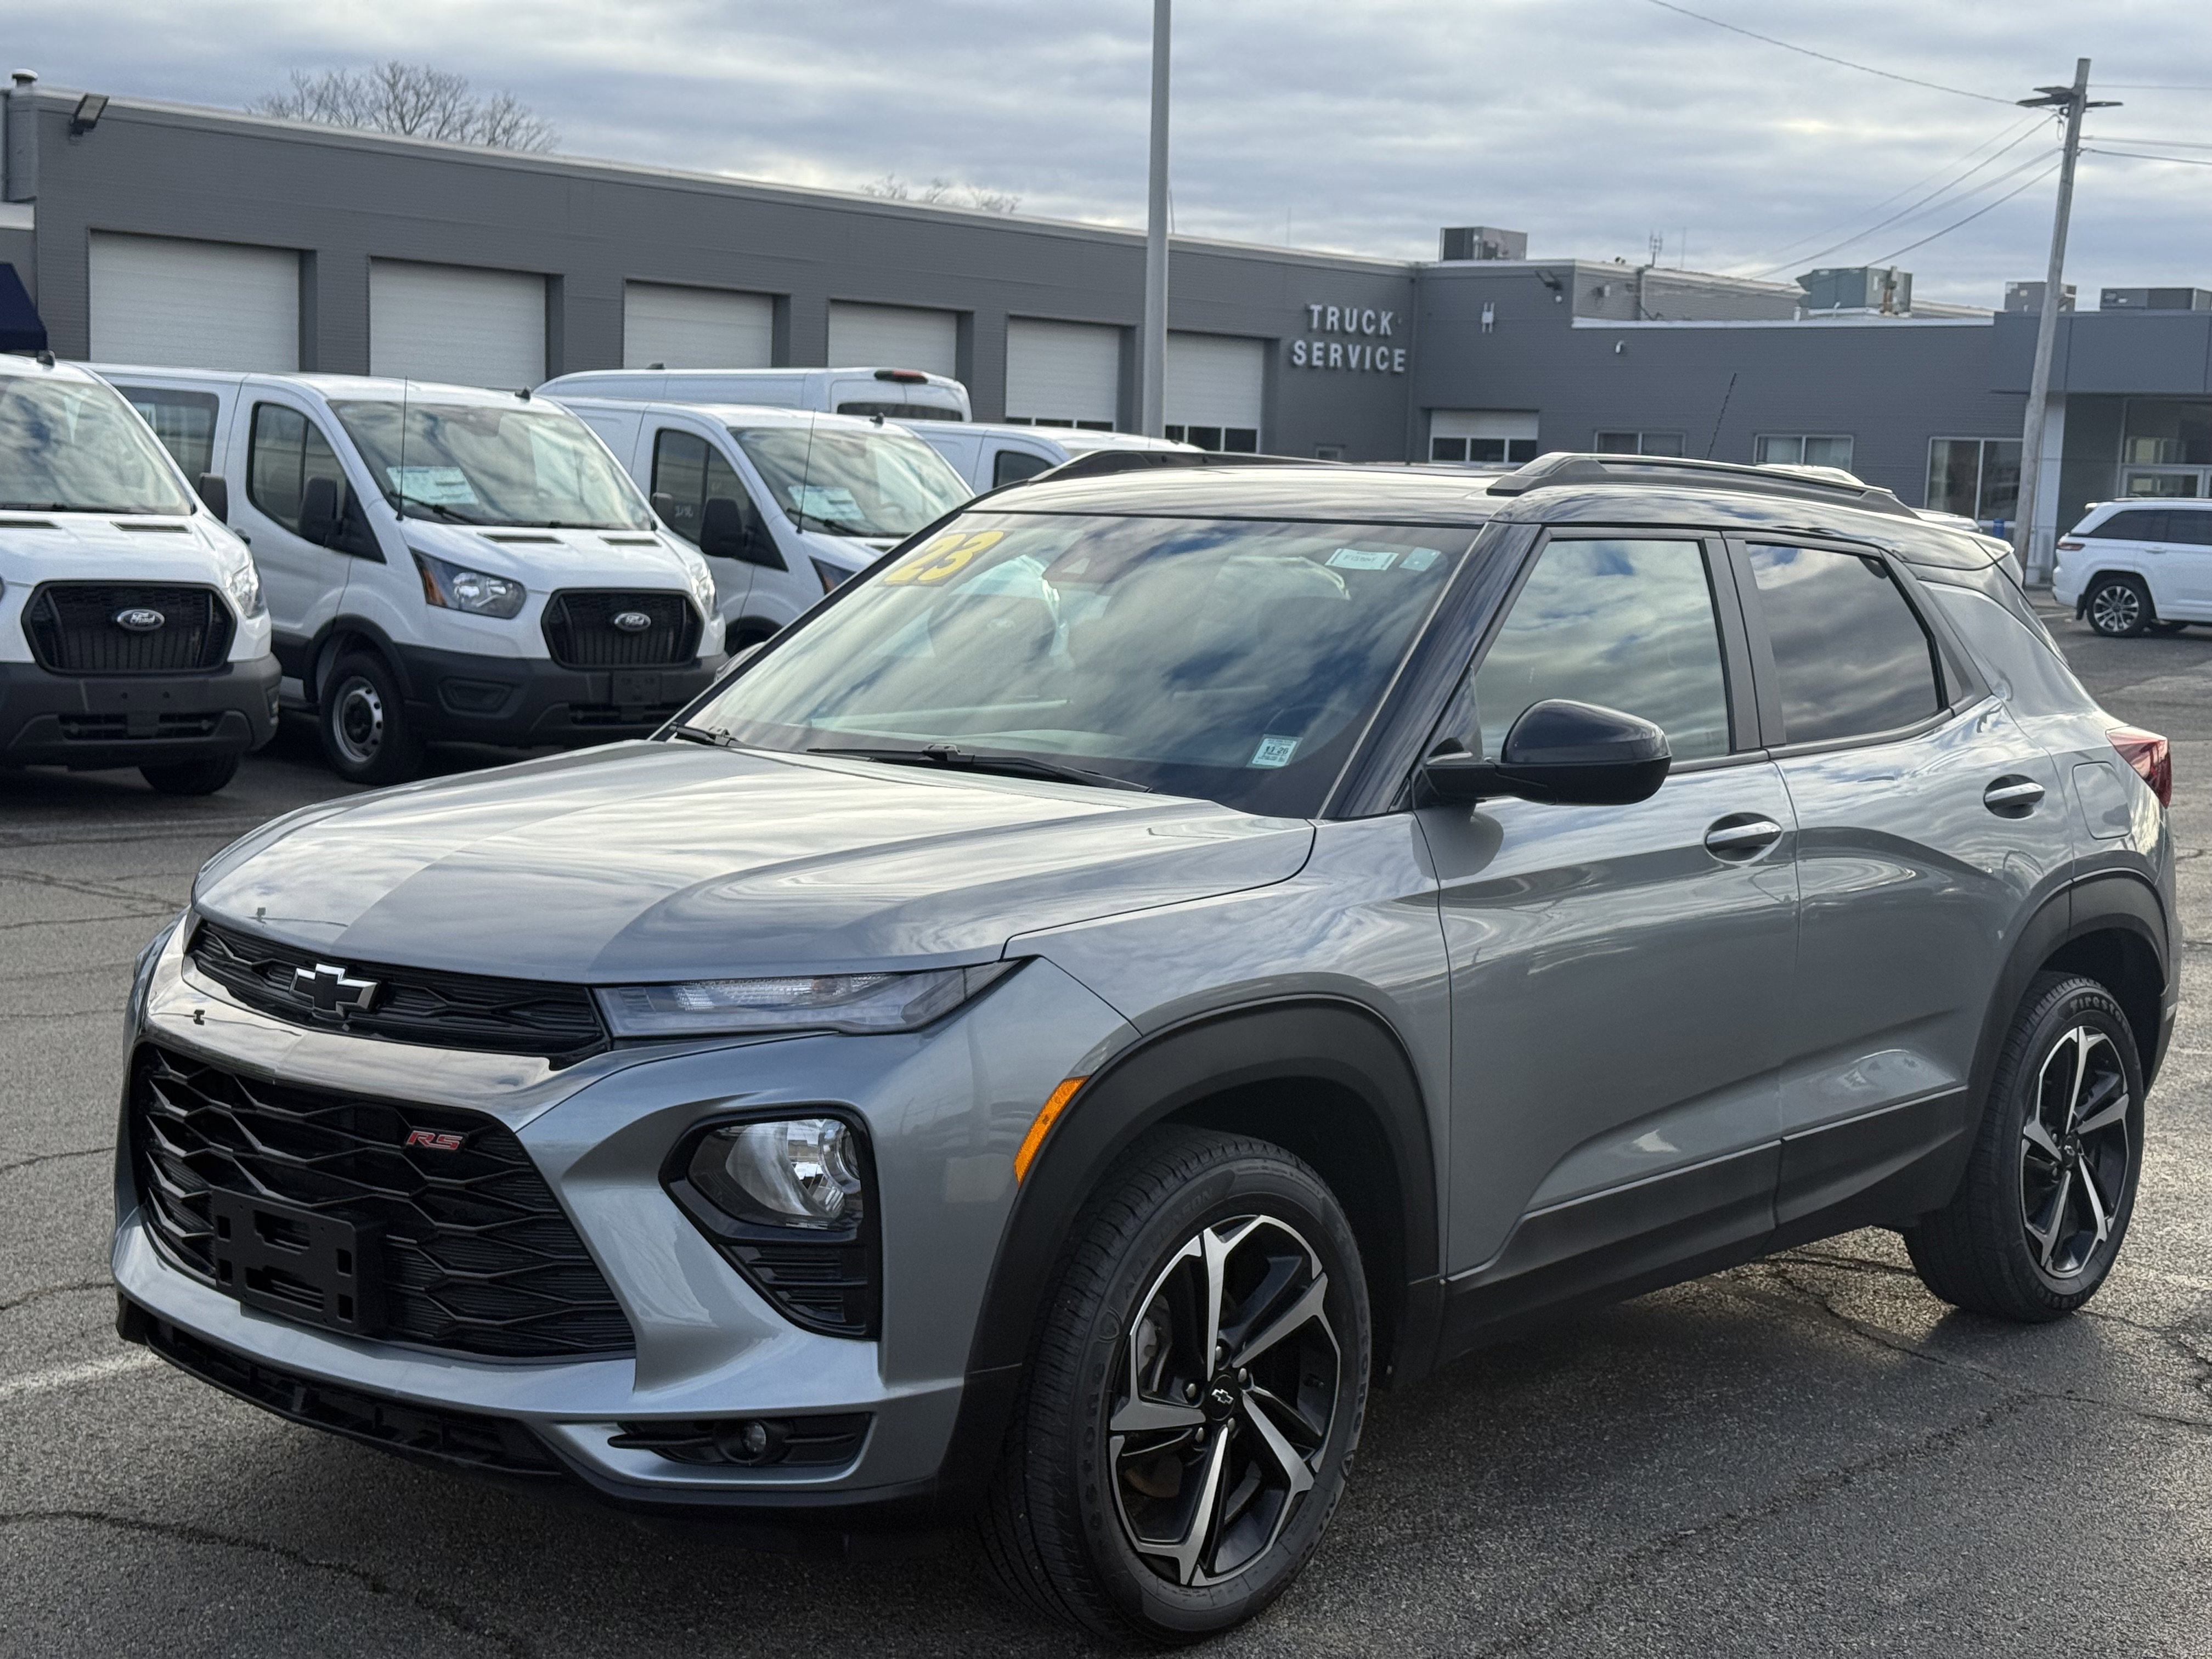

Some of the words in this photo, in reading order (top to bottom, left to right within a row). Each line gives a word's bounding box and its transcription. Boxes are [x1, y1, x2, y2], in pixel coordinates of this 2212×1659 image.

[1310, 304, 1393, 336] TRUCK
[1293, 340, 1406, 372] SERVICE
[884, 531, 1004, 582] 23
[406, 1130, 464, 1150] RS
